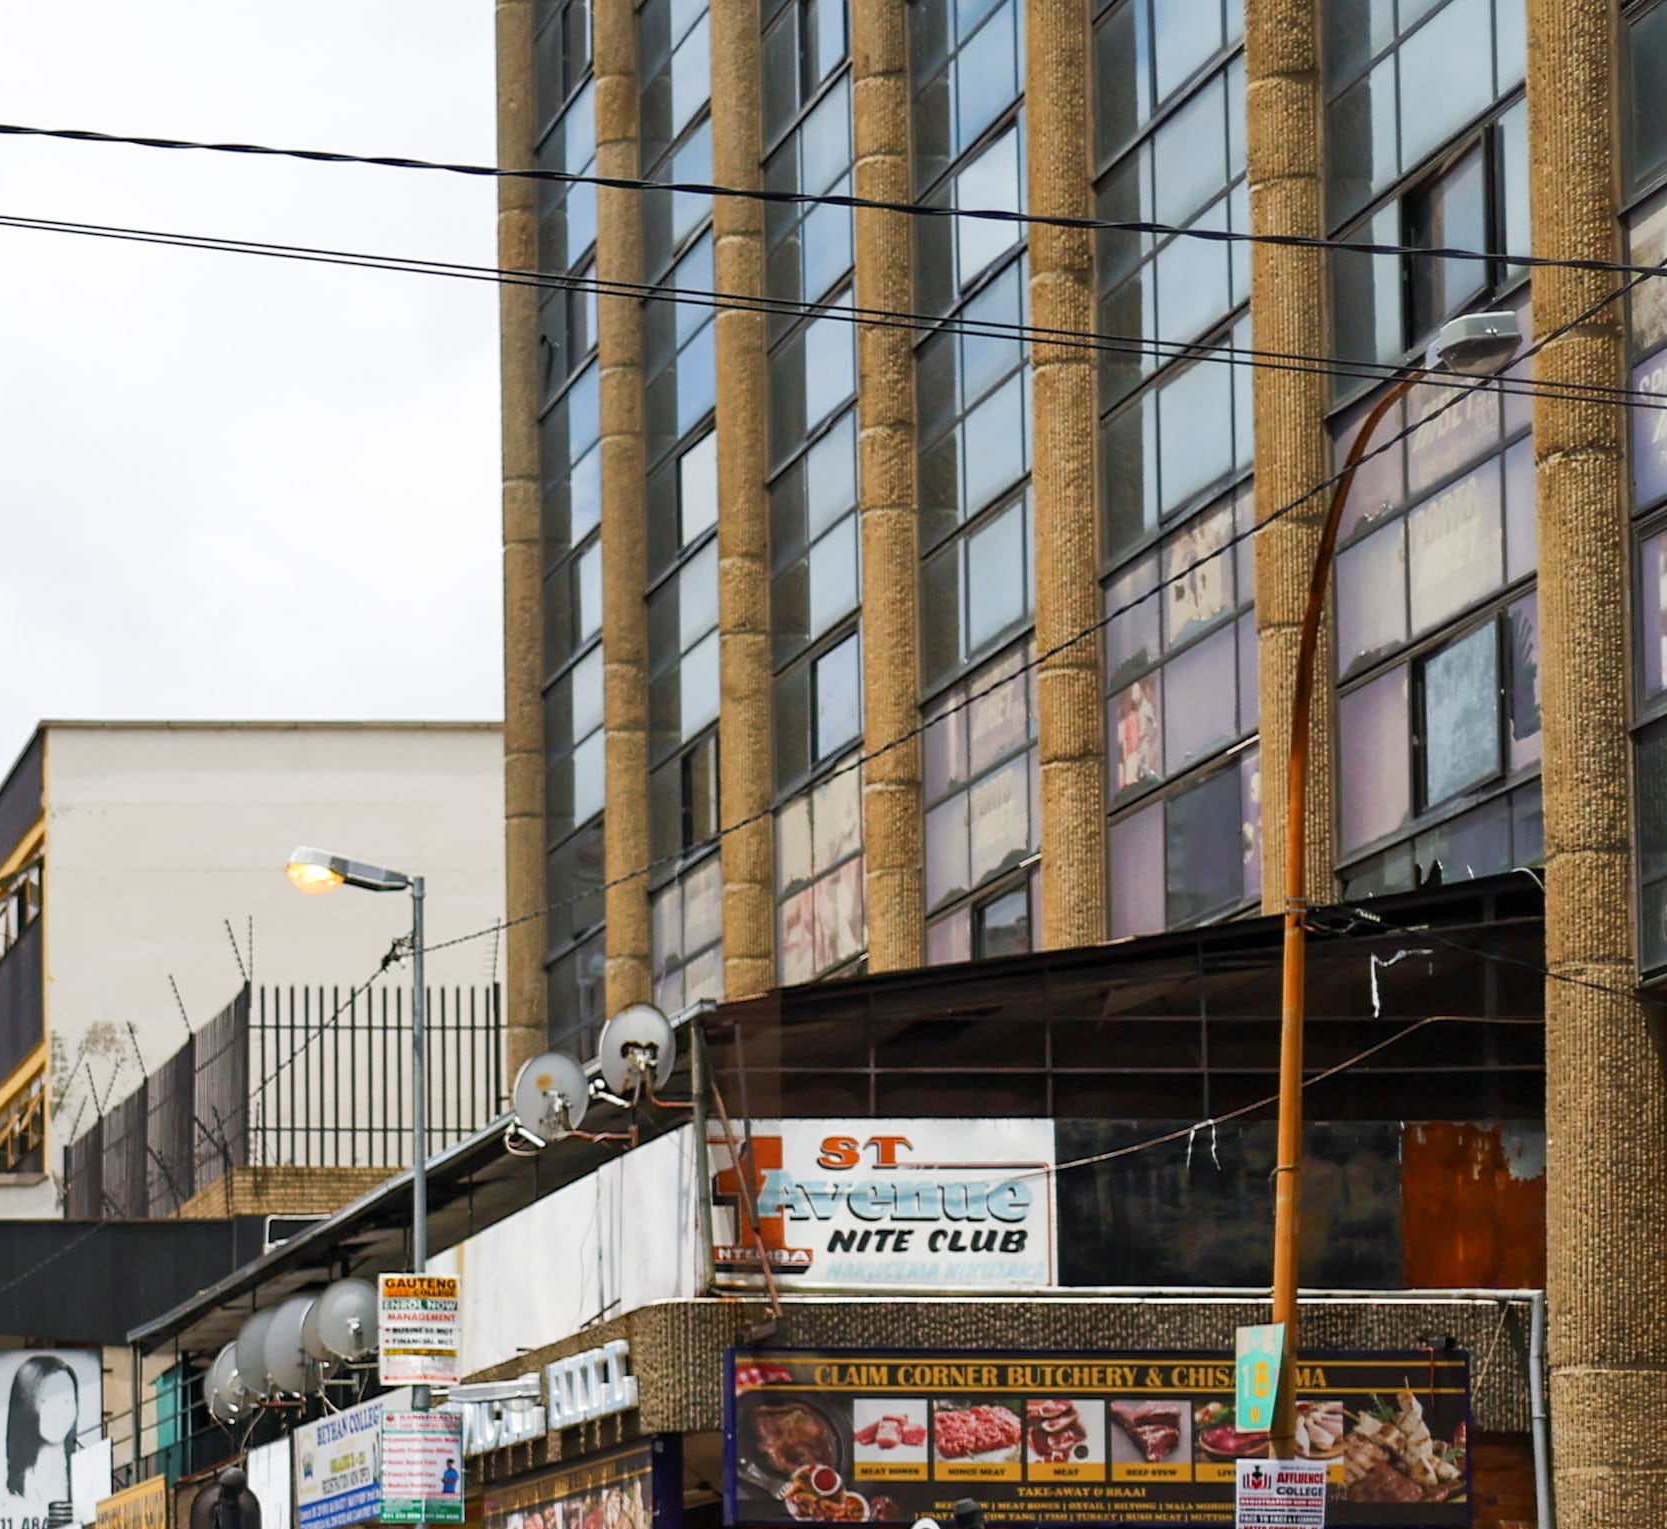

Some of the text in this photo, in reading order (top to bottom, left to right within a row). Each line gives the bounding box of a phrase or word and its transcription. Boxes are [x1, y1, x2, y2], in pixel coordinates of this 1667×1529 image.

[817, 1136, 914, 1170] ST
[757, 1168, 1034, 1222] Avenue
[827, 1229, 1029, 1253] NITE CLUB
[384, 1278, 457, 1289] GAUTENG
[414, 1289, 456, 1297] COLLEGE
[383, 1300, 458, 1311] ENROL NOW
[387, 1313, 457, 1322] MANAGEMENT
[813, 1366, 1164, 1387] CLAIM CORNER BUTCHERY &
[978, 1467, 1007, 1476] MEAT
[1053, 1467, 1079, 1476] MEAT
[1152, 1467, 1178, 1476] STEW
[1276, 1472, 1324, 1484] AFFLUENCE
[1017, 1487, 1147, 1498] TAKE-AWAY BRAAI
[1276, 1486, 1323, 1497] COLLEGE
[996, 1502, 1105, 1510] MEAT OXTAIL
[1043, 1513, 1233, 1521] FISH TURKEY MEAT MUTTON
